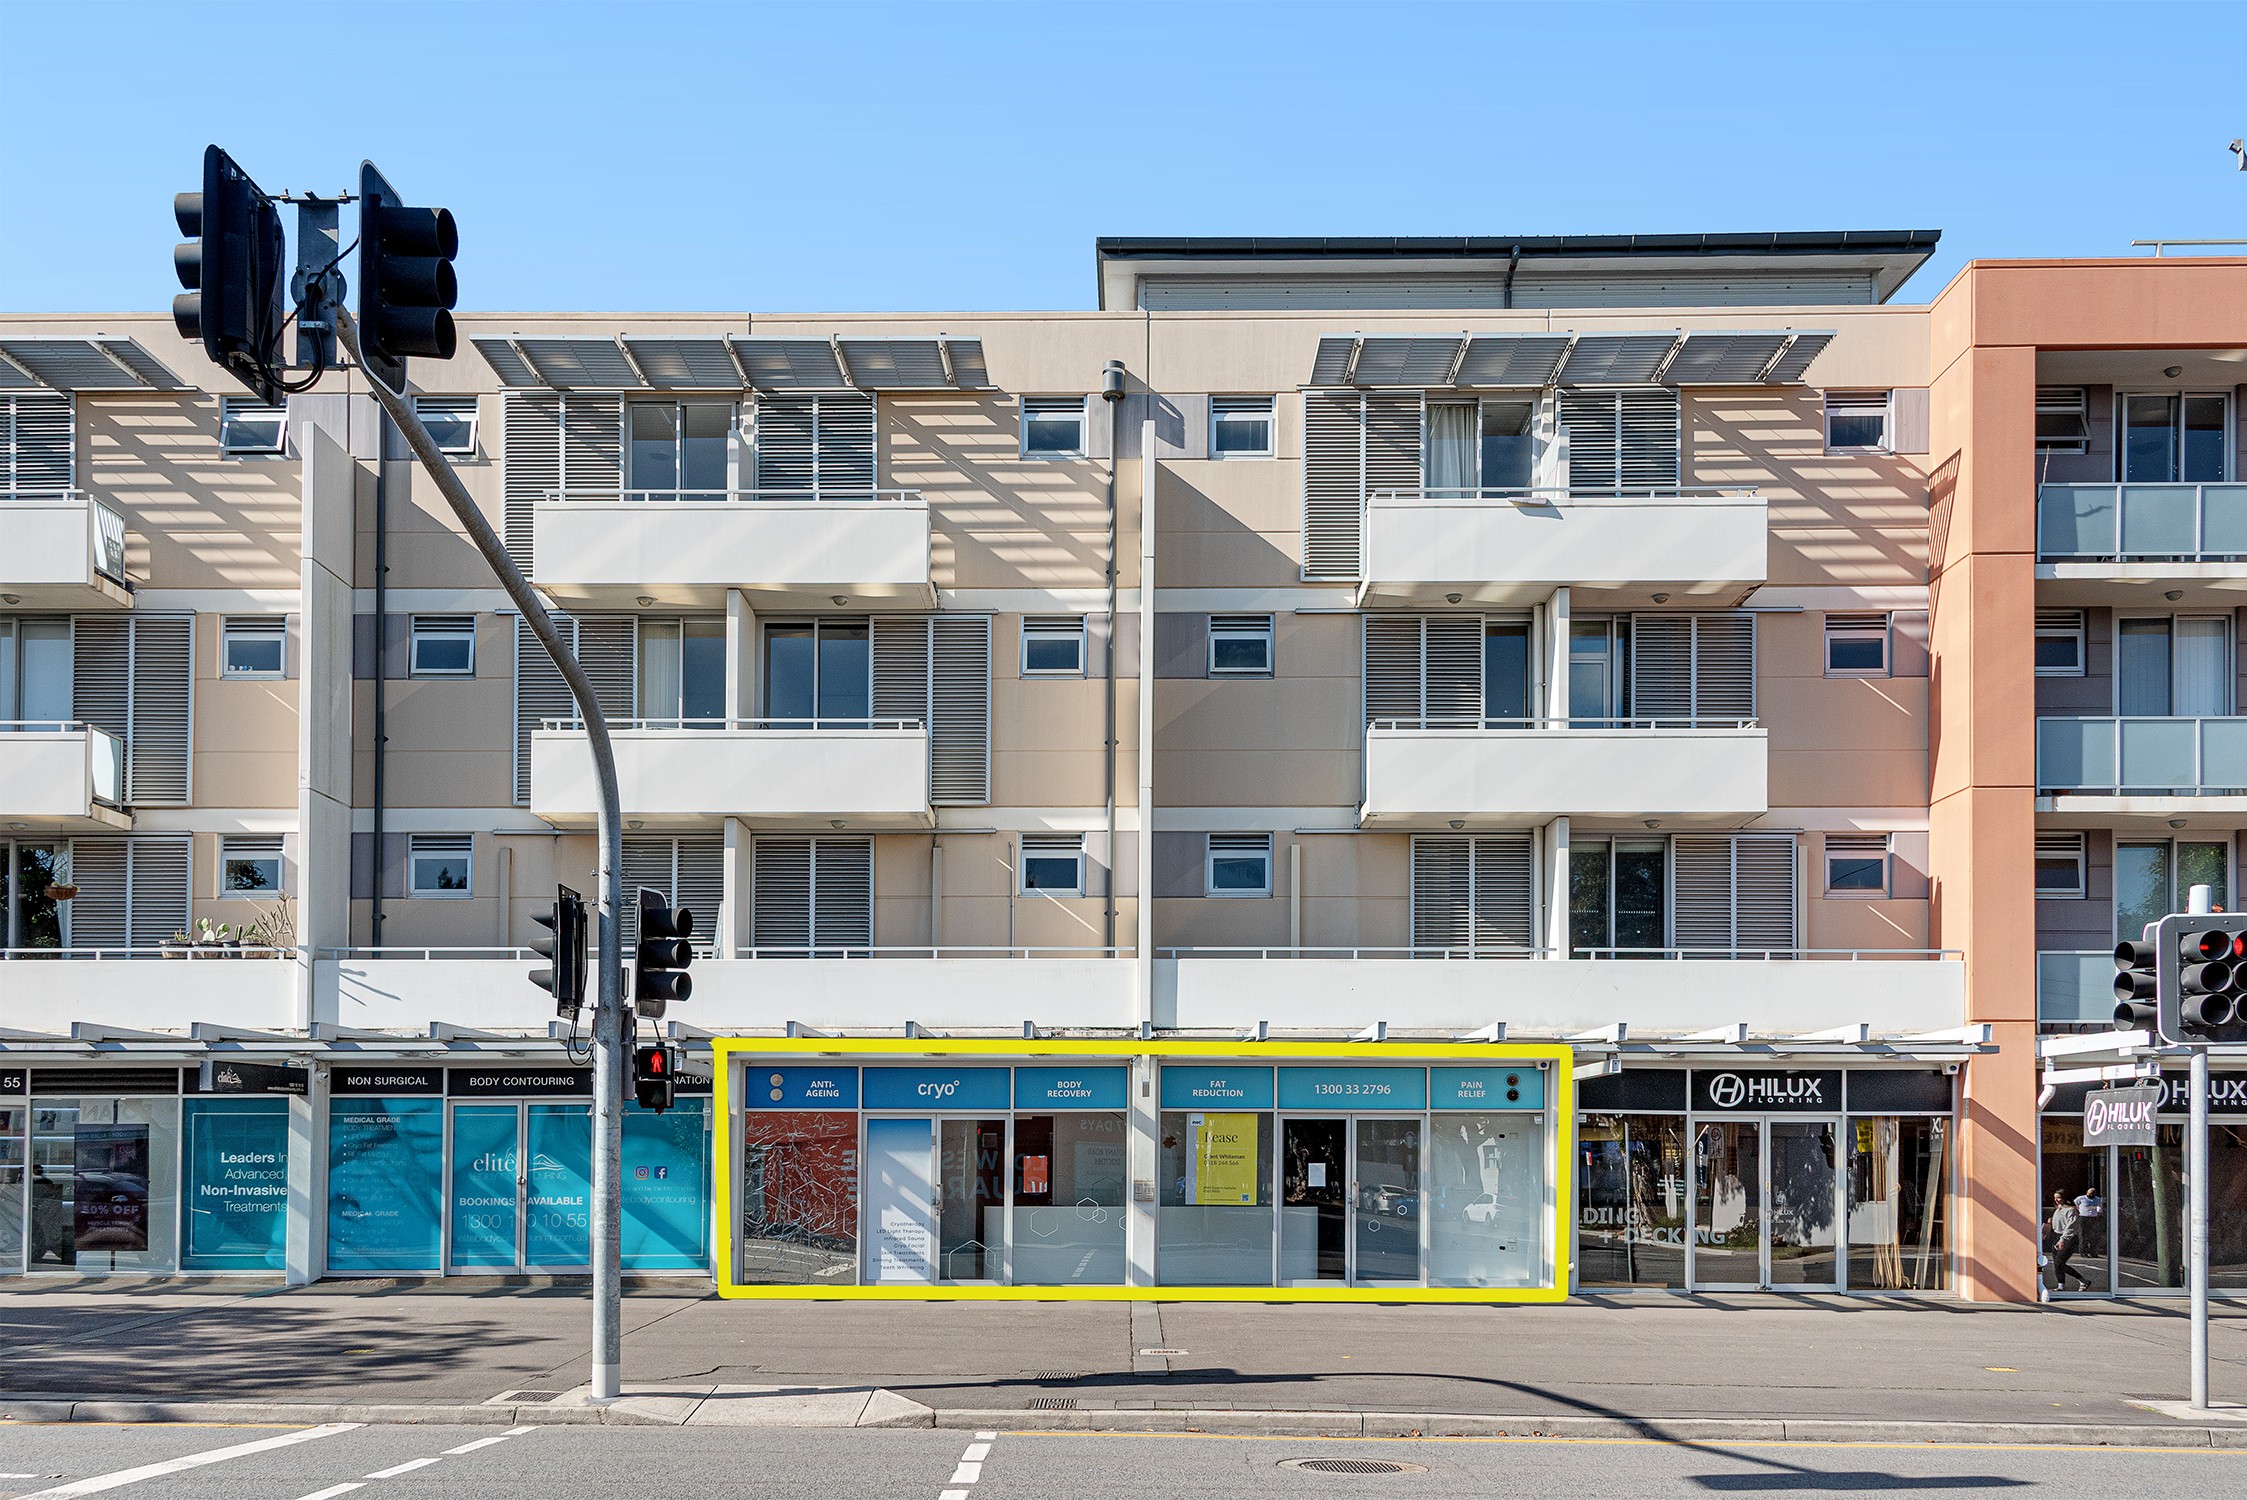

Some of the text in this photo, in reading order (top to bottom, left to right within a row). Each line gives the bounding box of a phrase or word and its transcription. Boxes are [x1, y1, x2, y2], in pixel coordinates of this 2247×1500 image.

[3, 1077, 20, 1088] 55
[348, 1076, 428, 1086] NON SURGICAL
[470, 1076, 575, 1087] BODY CONTOURING
[810, 1080, 835, 1088] ANTI-
[1057, 1081, 1082, 1089] BODY
[1210, 1080, 1226, 1088] FAT
[1461, 1081, 1483, 1089] PAIN
[805, 1089, 840, 1097] AGEING
[1192, 1089, 1244, 1097] REDUCTION
[1314, 1084, 1391, 1095] 1300 33 2796
[1748, 1078, 1822, 1097] HILUX
[2172, 1079, 2247, 1099] HUX
[1047, 1090, 1092, 1098] RECOVERY
[1457, 1090, 1486, 1098] RELIEF
[2108, 1101, 2152, 1123] HILUX
[221, 1152, 275, 1163] Leaders
[201, 1184, 288, 1196] Non-Invasive
[224, 1200, 288, 1212] Treatments
[459, 1196, 584, 1207] BOOKINGS AVAILABLE
[113, 1205, 139, 1215] OFF
[462, 1213, 587, 1229] 1300 10 10 55
